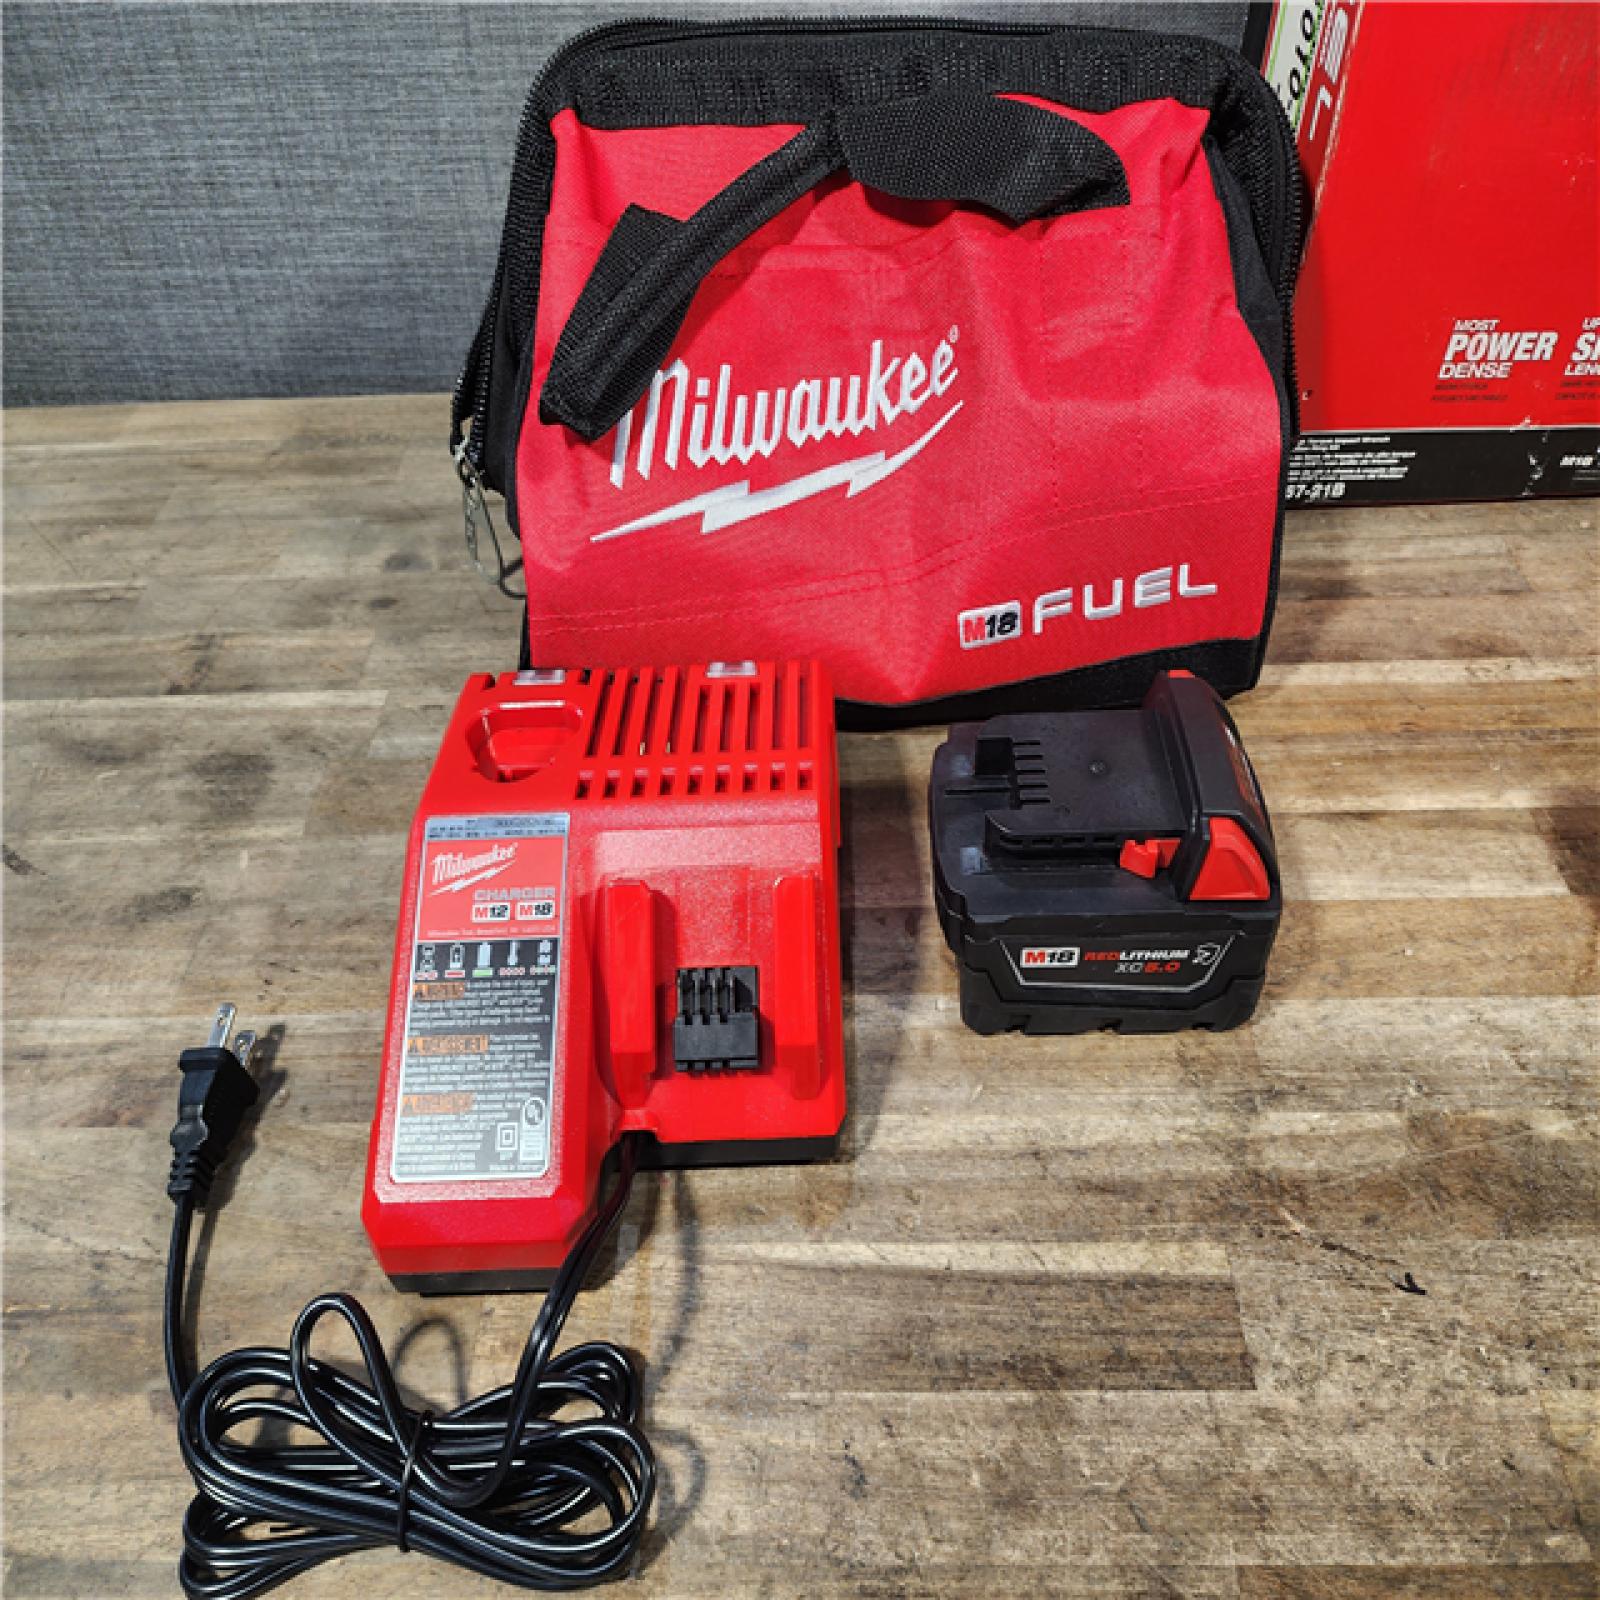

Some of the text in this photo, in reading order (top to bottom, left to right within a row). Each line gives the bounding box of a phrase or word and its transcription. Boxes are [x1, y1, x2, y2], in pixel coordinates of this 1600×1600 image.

[1444, 331, 1558, 361] POWER
[1438, 362, 1513, 379] DENSE
[610, 339, 959, 490] Milwaukee
[963, 563, 1218, 643] M18 FUEL
[1024, 951, 1076, 964] M18
